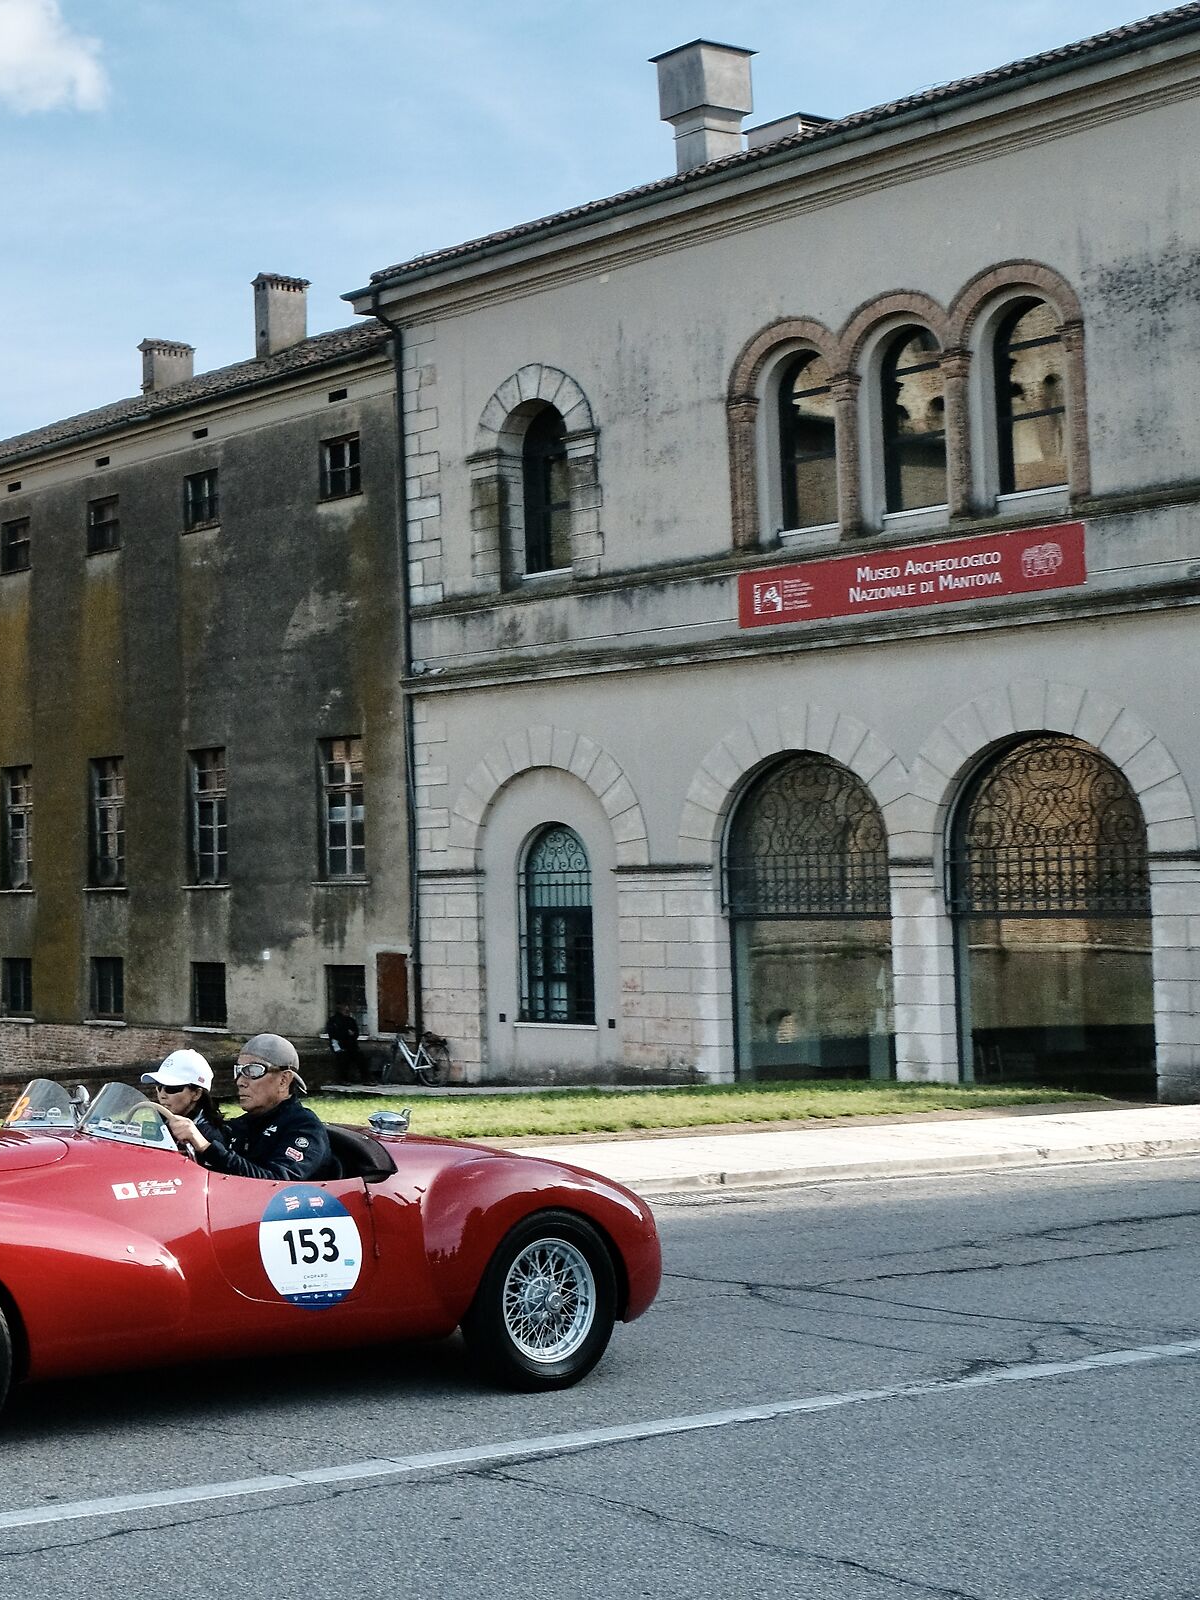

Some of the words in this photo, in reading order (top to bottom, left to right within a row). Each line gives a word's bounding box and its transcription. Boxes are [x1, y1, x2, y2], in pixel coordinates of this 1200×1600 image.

[856, 566, 900, 583] MUSEO
[904, 551, 1002, 576] ARCHEOLOGICO
[849, 583, 916, 603] NAZIONALE
[920, 580, 935, 594] DI
[938, 572, 1003, 591] MANTOVA
[283, 1227, 340, 1265] 153
